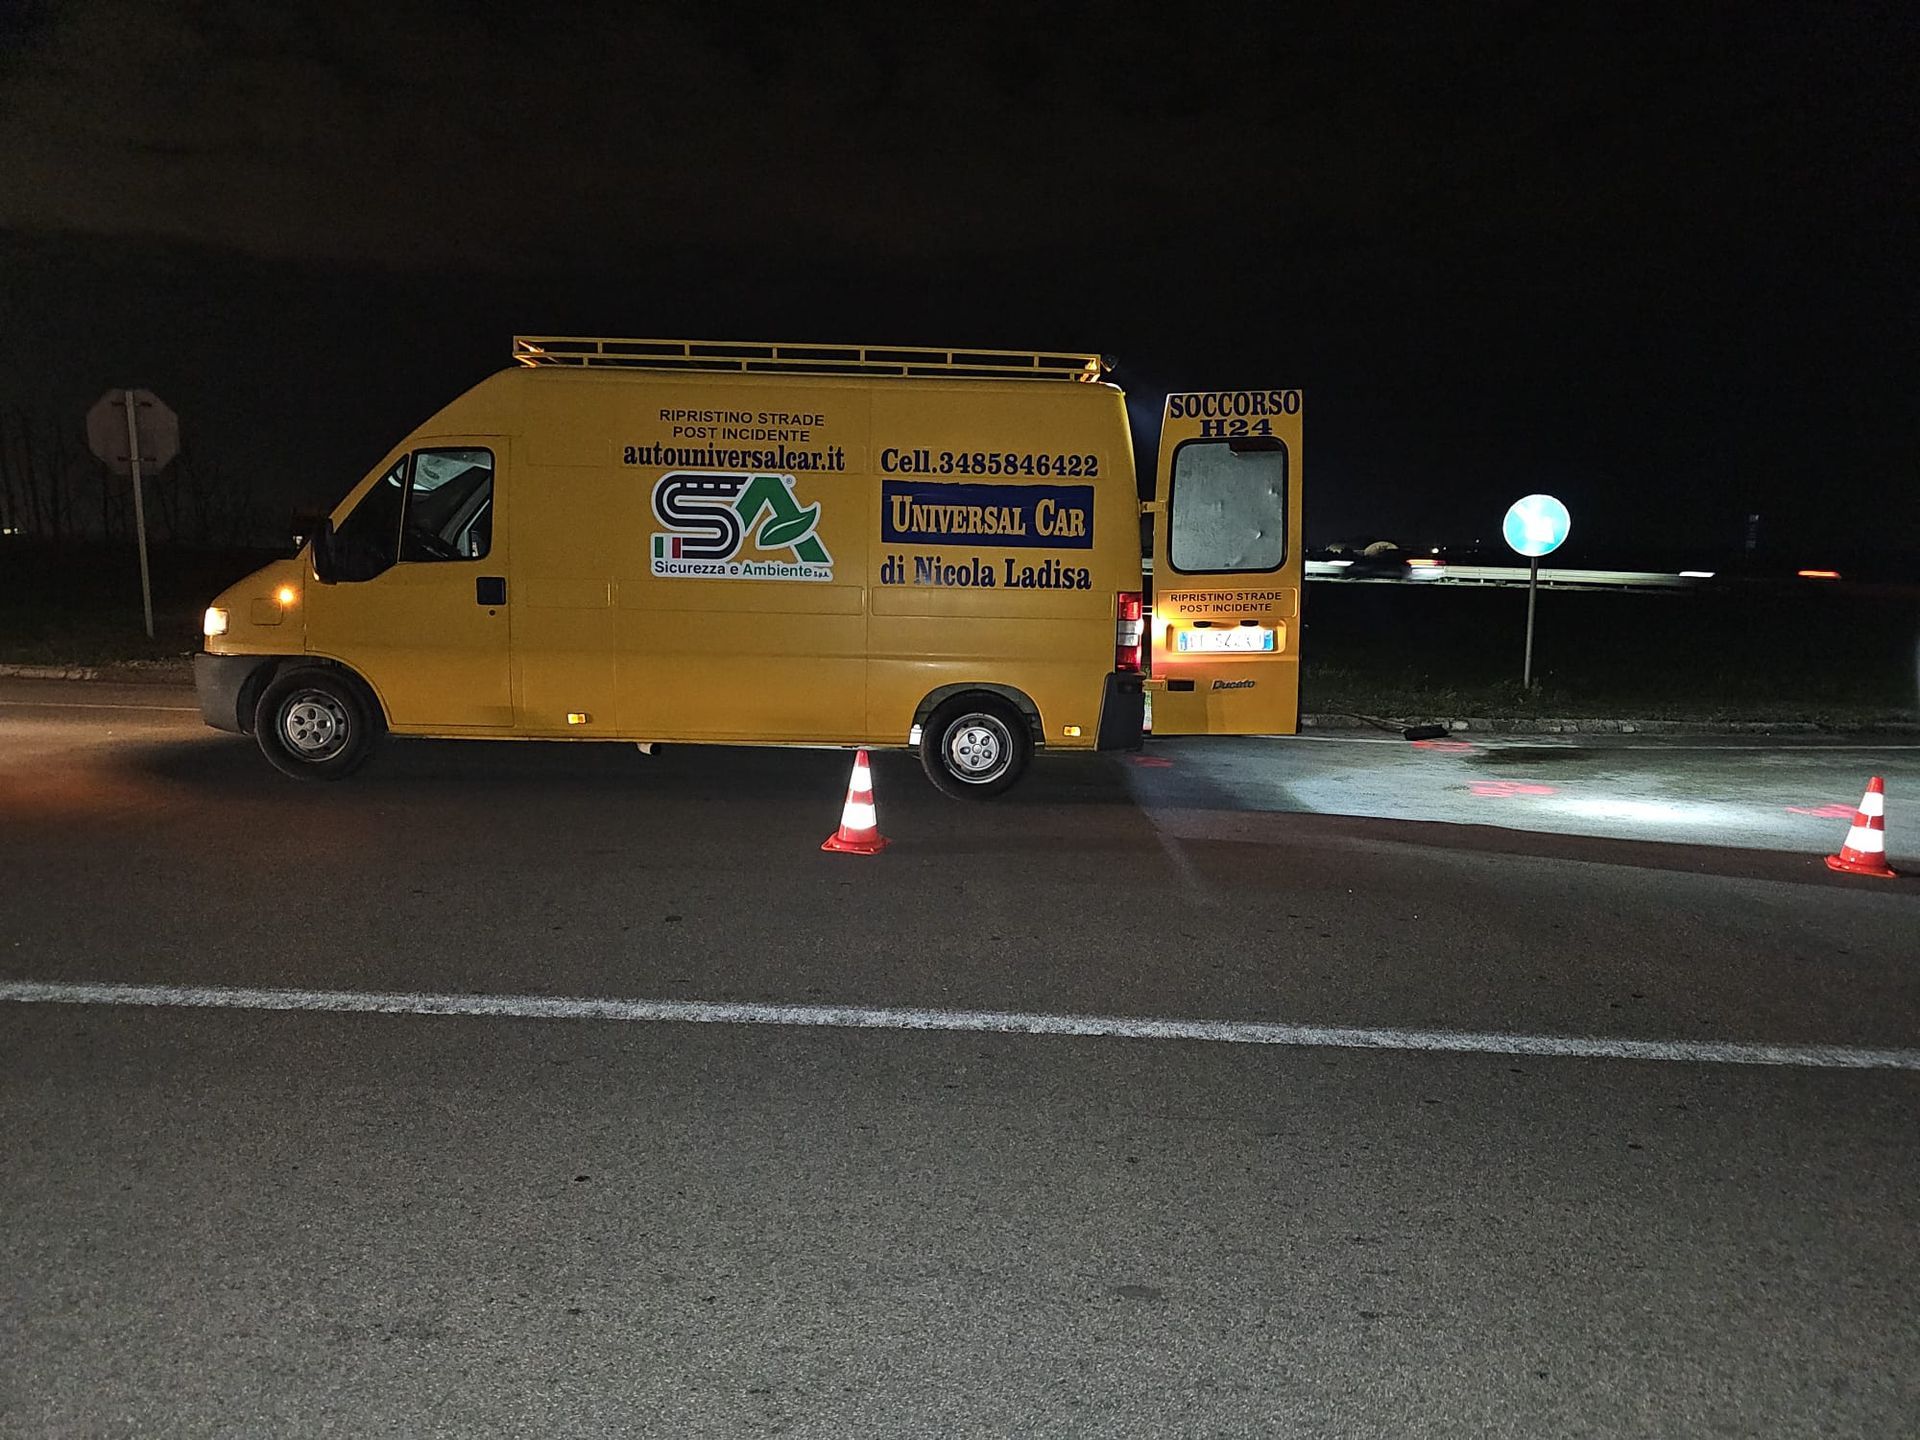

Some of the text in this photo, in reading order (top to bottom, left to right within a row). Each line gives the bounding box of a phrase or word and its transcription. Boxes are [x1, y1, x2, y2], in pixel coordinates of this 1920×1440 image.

[1170, 391, 1300, 419] SOCCORSO
[660, 409, 825, 427] RIPRISTINO STRADE
[673, 426, 810, 442] POST INCIDENTE
[1200, 418, 1273, 437] H24
[623, 441, 845, 472] autouniversalcar.it
[881, 448, 1098, 476] Cell.3485846422
[654, 560, 726, 576] Sicurezza
[730, 565, 739, 575] e
[743, 563, 813, 578] Ambiente
[881, 555, 1092, 589] di Nicola Ladisa
[1170, 592, 1282, 602] RIPRISTINO STRADE
[1180, 603, 1272, 613] POST INCIDENTE
